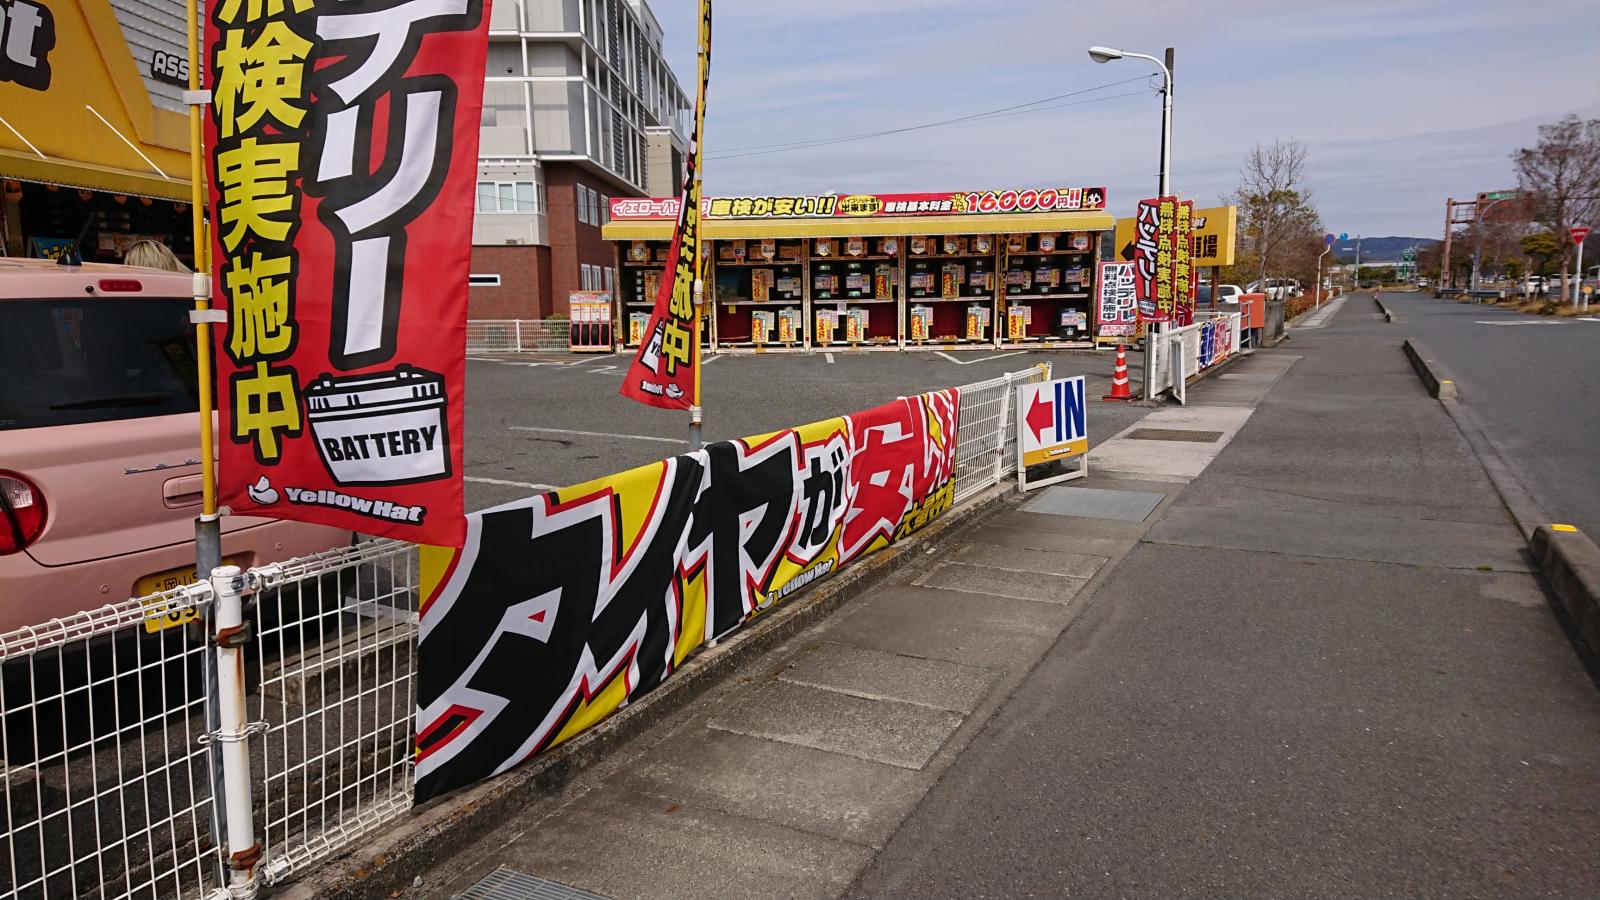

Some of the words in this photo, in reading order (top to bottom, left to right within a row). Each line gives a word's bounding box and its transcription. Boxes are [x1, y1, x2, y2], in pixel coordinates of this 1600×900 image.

[213, 0, 315, 459] 検実施中
[711, 197, 834, 216] 車検が安い!!
[1102, 265, 1118, 320] 無料点検実施中
[1055, 379, 1085, 442] IN
[322, 425, 437, 462] BATTERY
